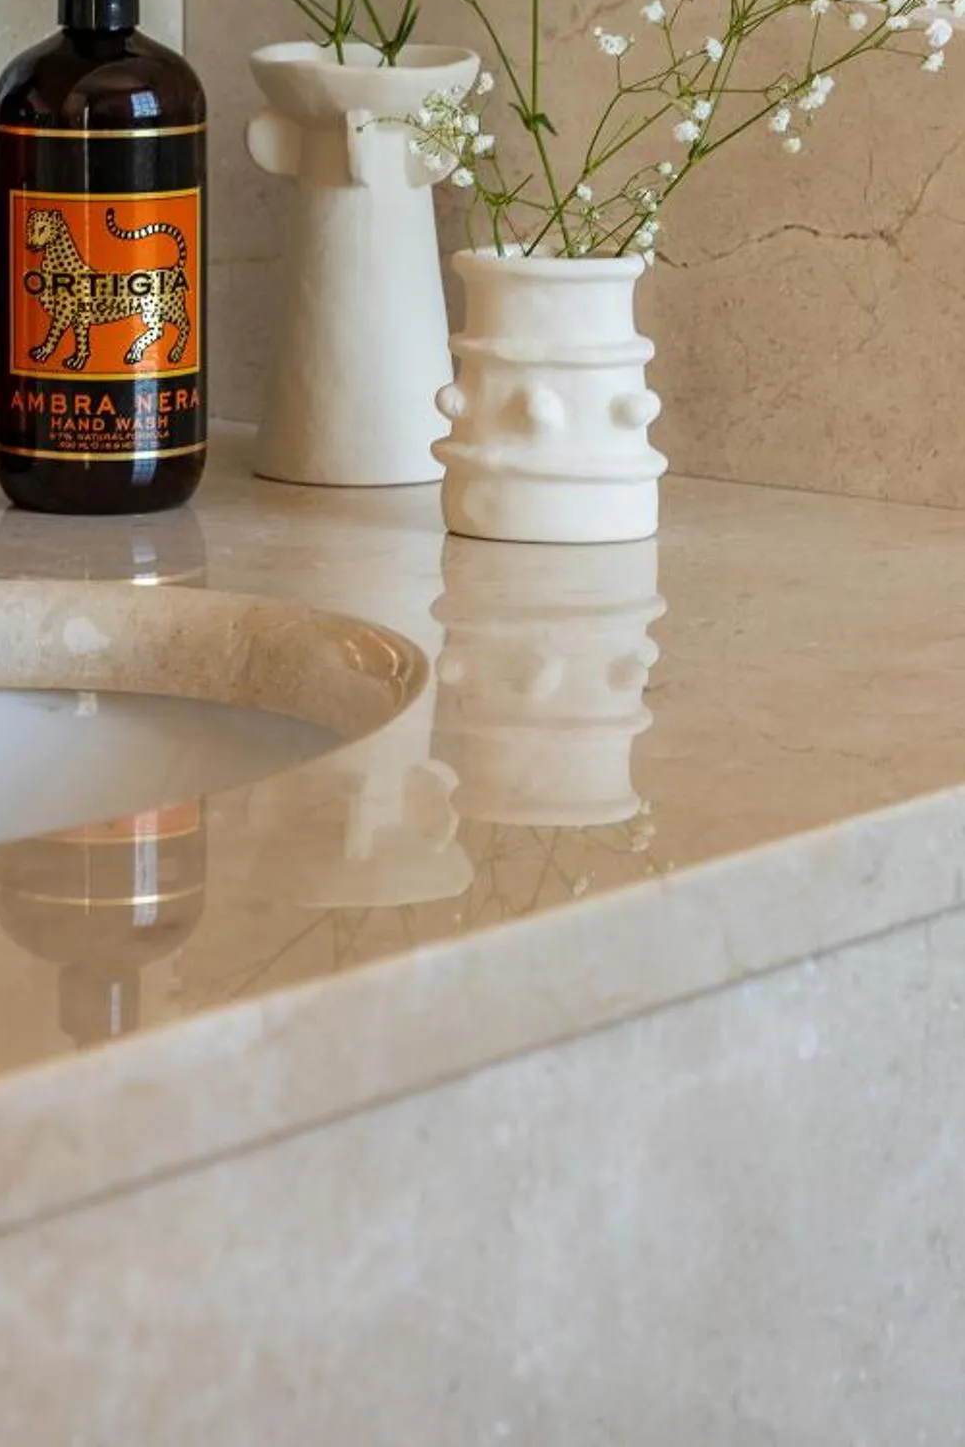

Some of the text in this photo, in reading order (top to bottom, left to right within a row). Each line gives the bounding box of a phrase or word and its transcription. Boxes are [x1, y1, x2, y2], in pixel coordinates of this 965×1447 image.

[24, 269, 189, 297] ORTIGIA
[11, 388, 201, 416] AMBRA NERA
[50, 414, 169, 432] HAND WASH
